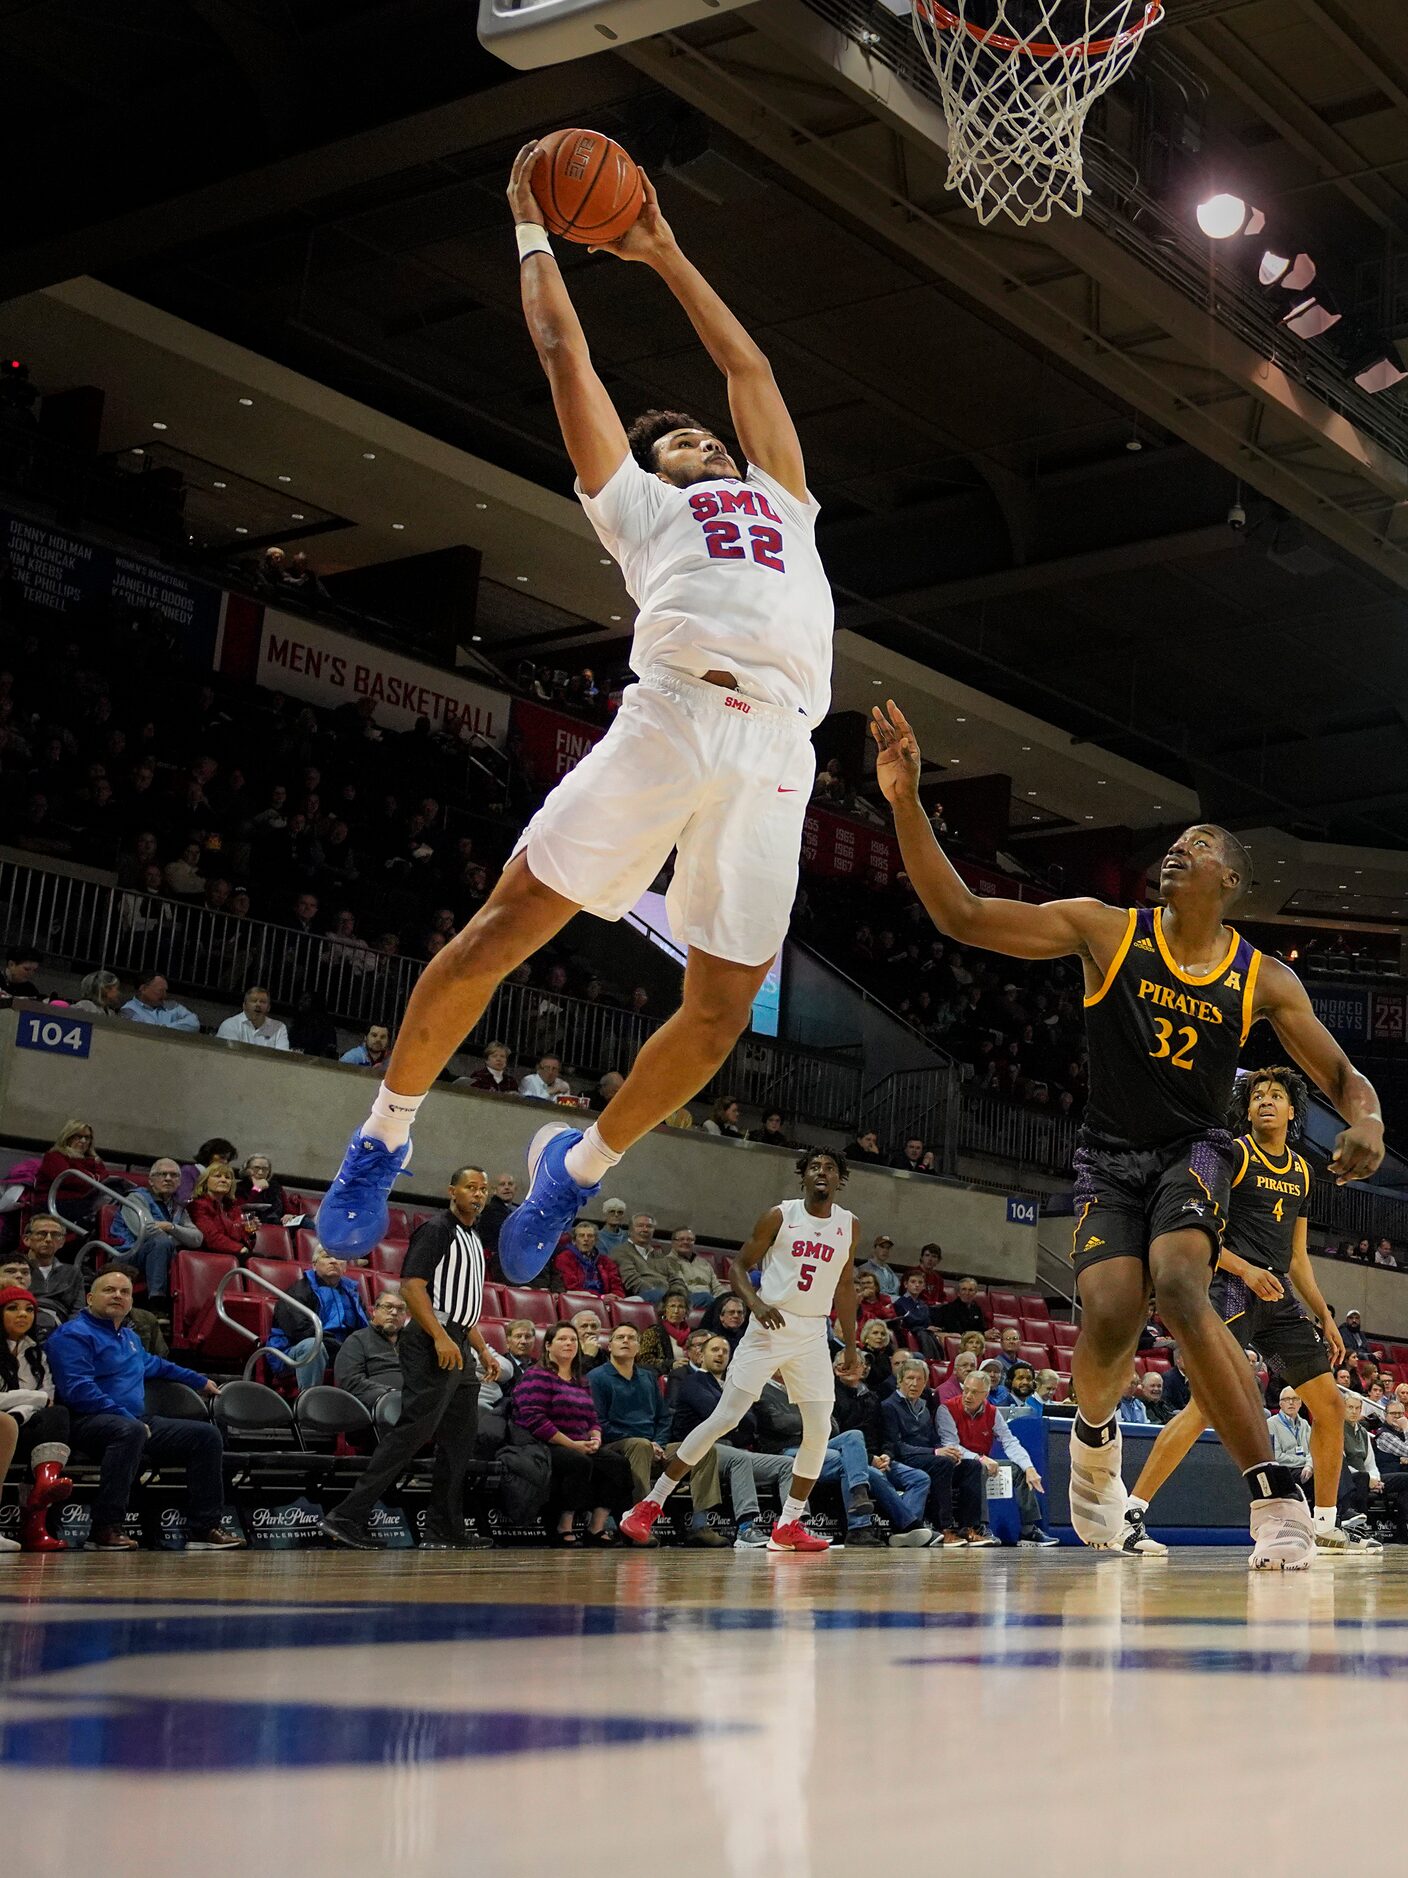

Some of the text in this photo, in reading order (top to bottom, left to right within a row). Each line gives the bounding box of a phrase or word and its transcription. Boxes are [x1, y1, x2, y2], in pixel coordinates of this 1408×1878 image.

[702, 520, 786, 574] 22
[267, 635, 496, 739] MEN'S BASKETBALL
[724, 696, 752, 714] SMU
[1137, 978, 1223, 1024] PIRATES
[1312, 998, 1362, 1016] ONORED
[1376, 1004, 1403, 1030] 23
[29, 1019, 82, 1050] 104
[1149, 1017, 1198, 1070] 32
[1256, 1175, 1300, 1197] PIRATES
[1012, 1203, 1034, 1221] 104
[1272, 1198, 1284, 1222] 4
[791, 1240, 835, 1262] SMU
[797, 1263, 817, 1292] 5
[256, 1530, 324, 1540] DEALERSHIPS
